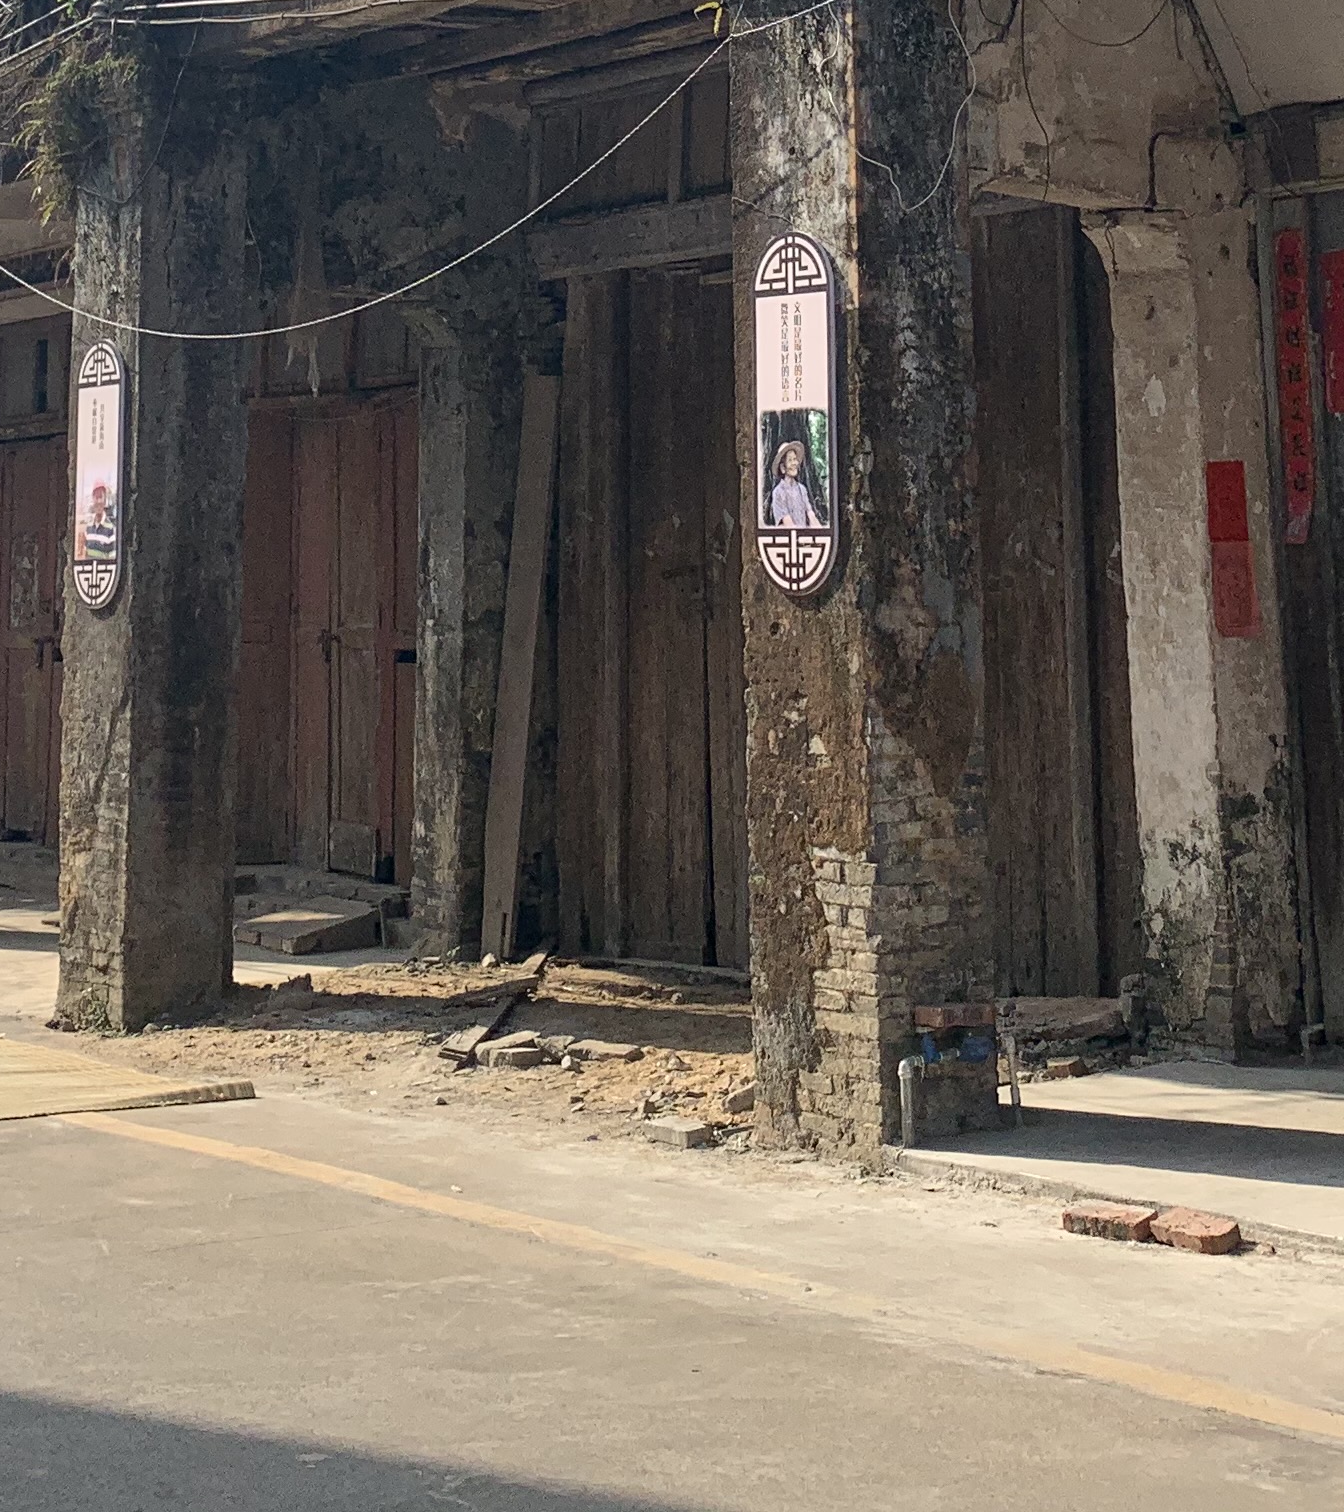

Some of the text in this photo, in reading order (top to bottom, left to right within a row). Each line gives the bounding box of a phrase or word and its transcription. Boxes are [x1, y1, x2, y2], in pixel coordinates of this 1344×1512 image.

[781, 303, 789, 402] 微笑是最好的语言
[794, 301, 803, 402] 文明是最好的名片
